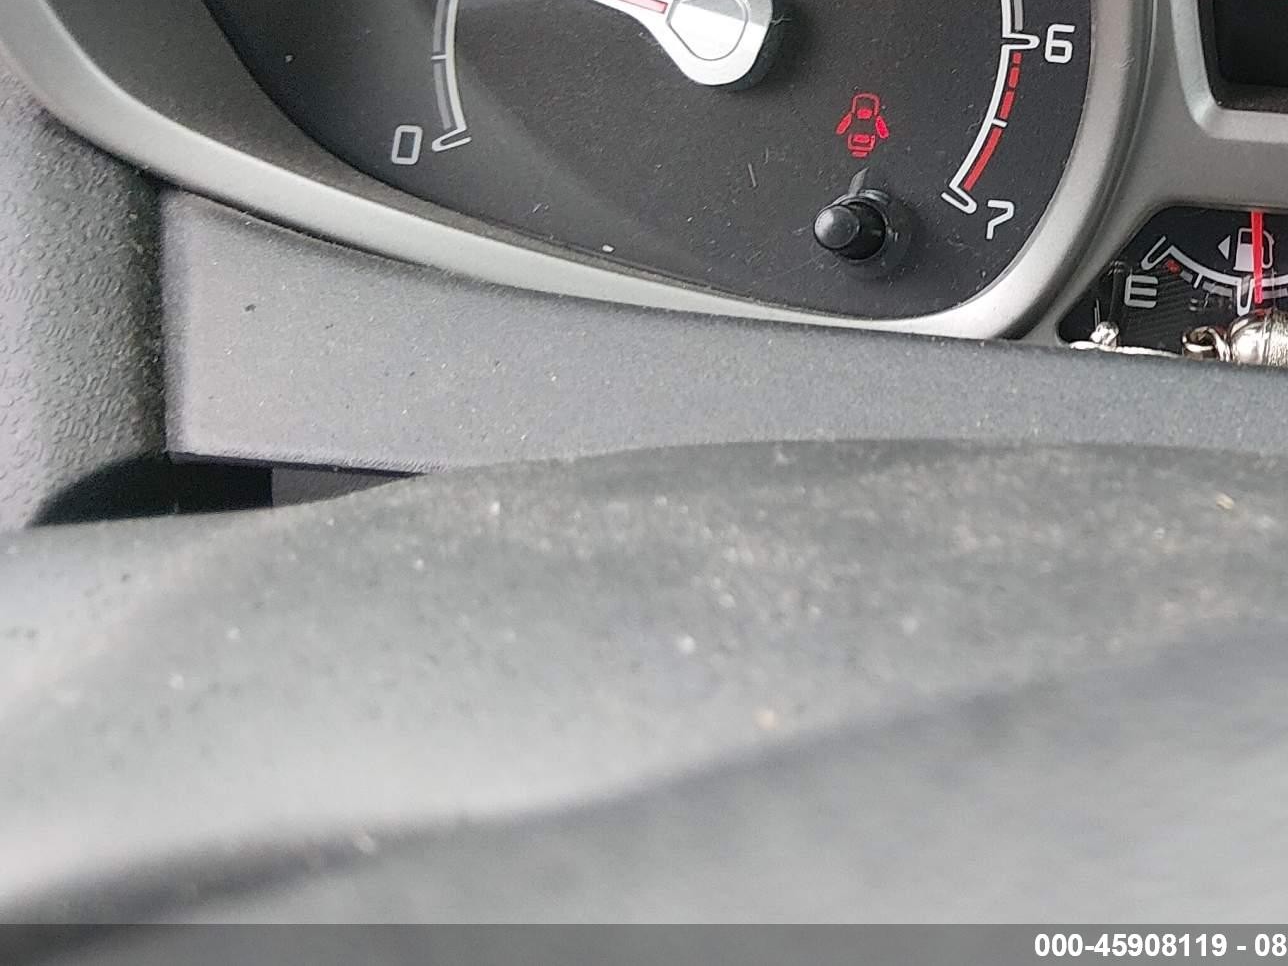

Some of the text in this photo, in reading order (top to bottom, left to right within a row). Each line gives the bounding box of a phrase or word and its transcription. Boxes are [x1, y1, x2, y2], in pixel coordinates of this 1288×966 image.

[1044, 25, 1074, 63] 6
[391, 125, 422, 165] 0
[986, 201, 1015, 240] 7
[1124, 275, 1158, 308] E
